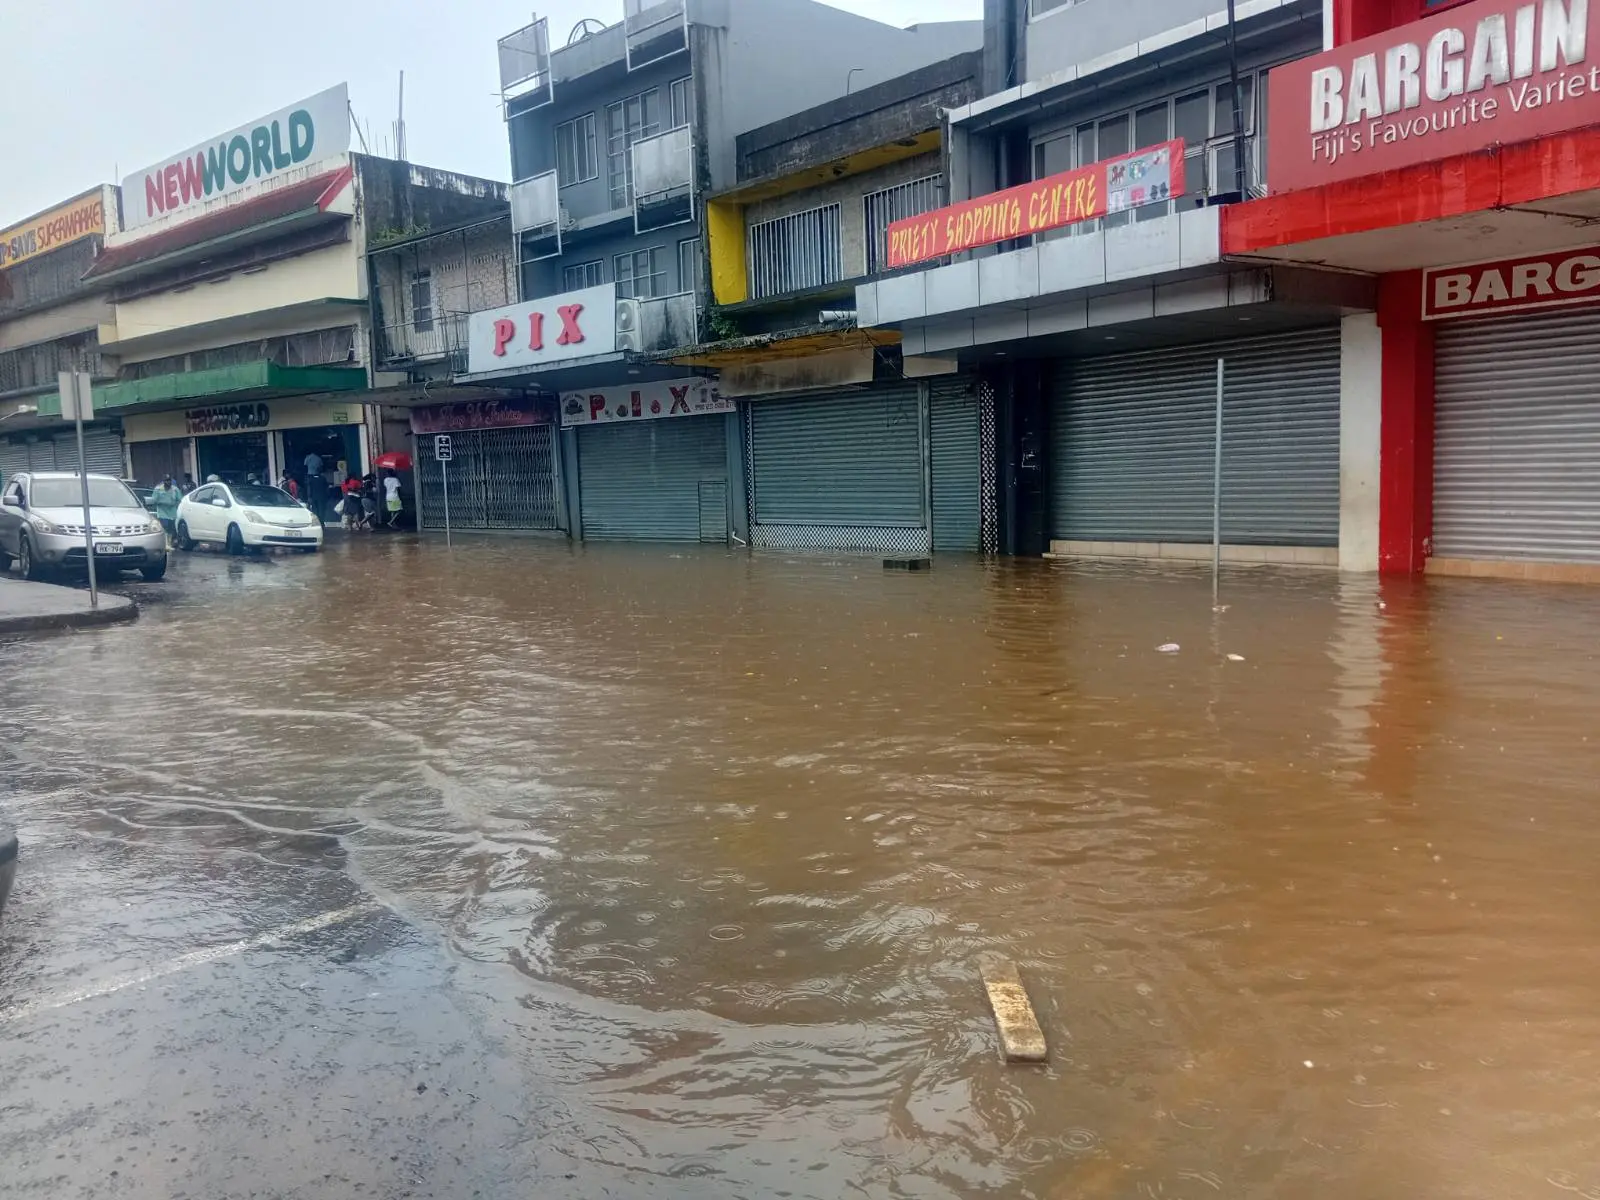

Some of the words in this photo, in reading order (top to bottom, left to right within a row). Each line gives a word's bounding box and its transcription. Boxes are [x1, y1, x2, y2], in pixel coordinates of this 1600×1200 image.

[1310, 0, 1588, 133] BARGAIN
[1311, 128, 1361, 163] Fiji's
[1370, 97, 1498, 147] Favourite
[1507, 66, 1600, 112] Variet
[946, 198, 1021, 254] SHOPPING
[1028, 174, 1096, 229] CENTRE
[1434, 255, 1600, 308] BARG
